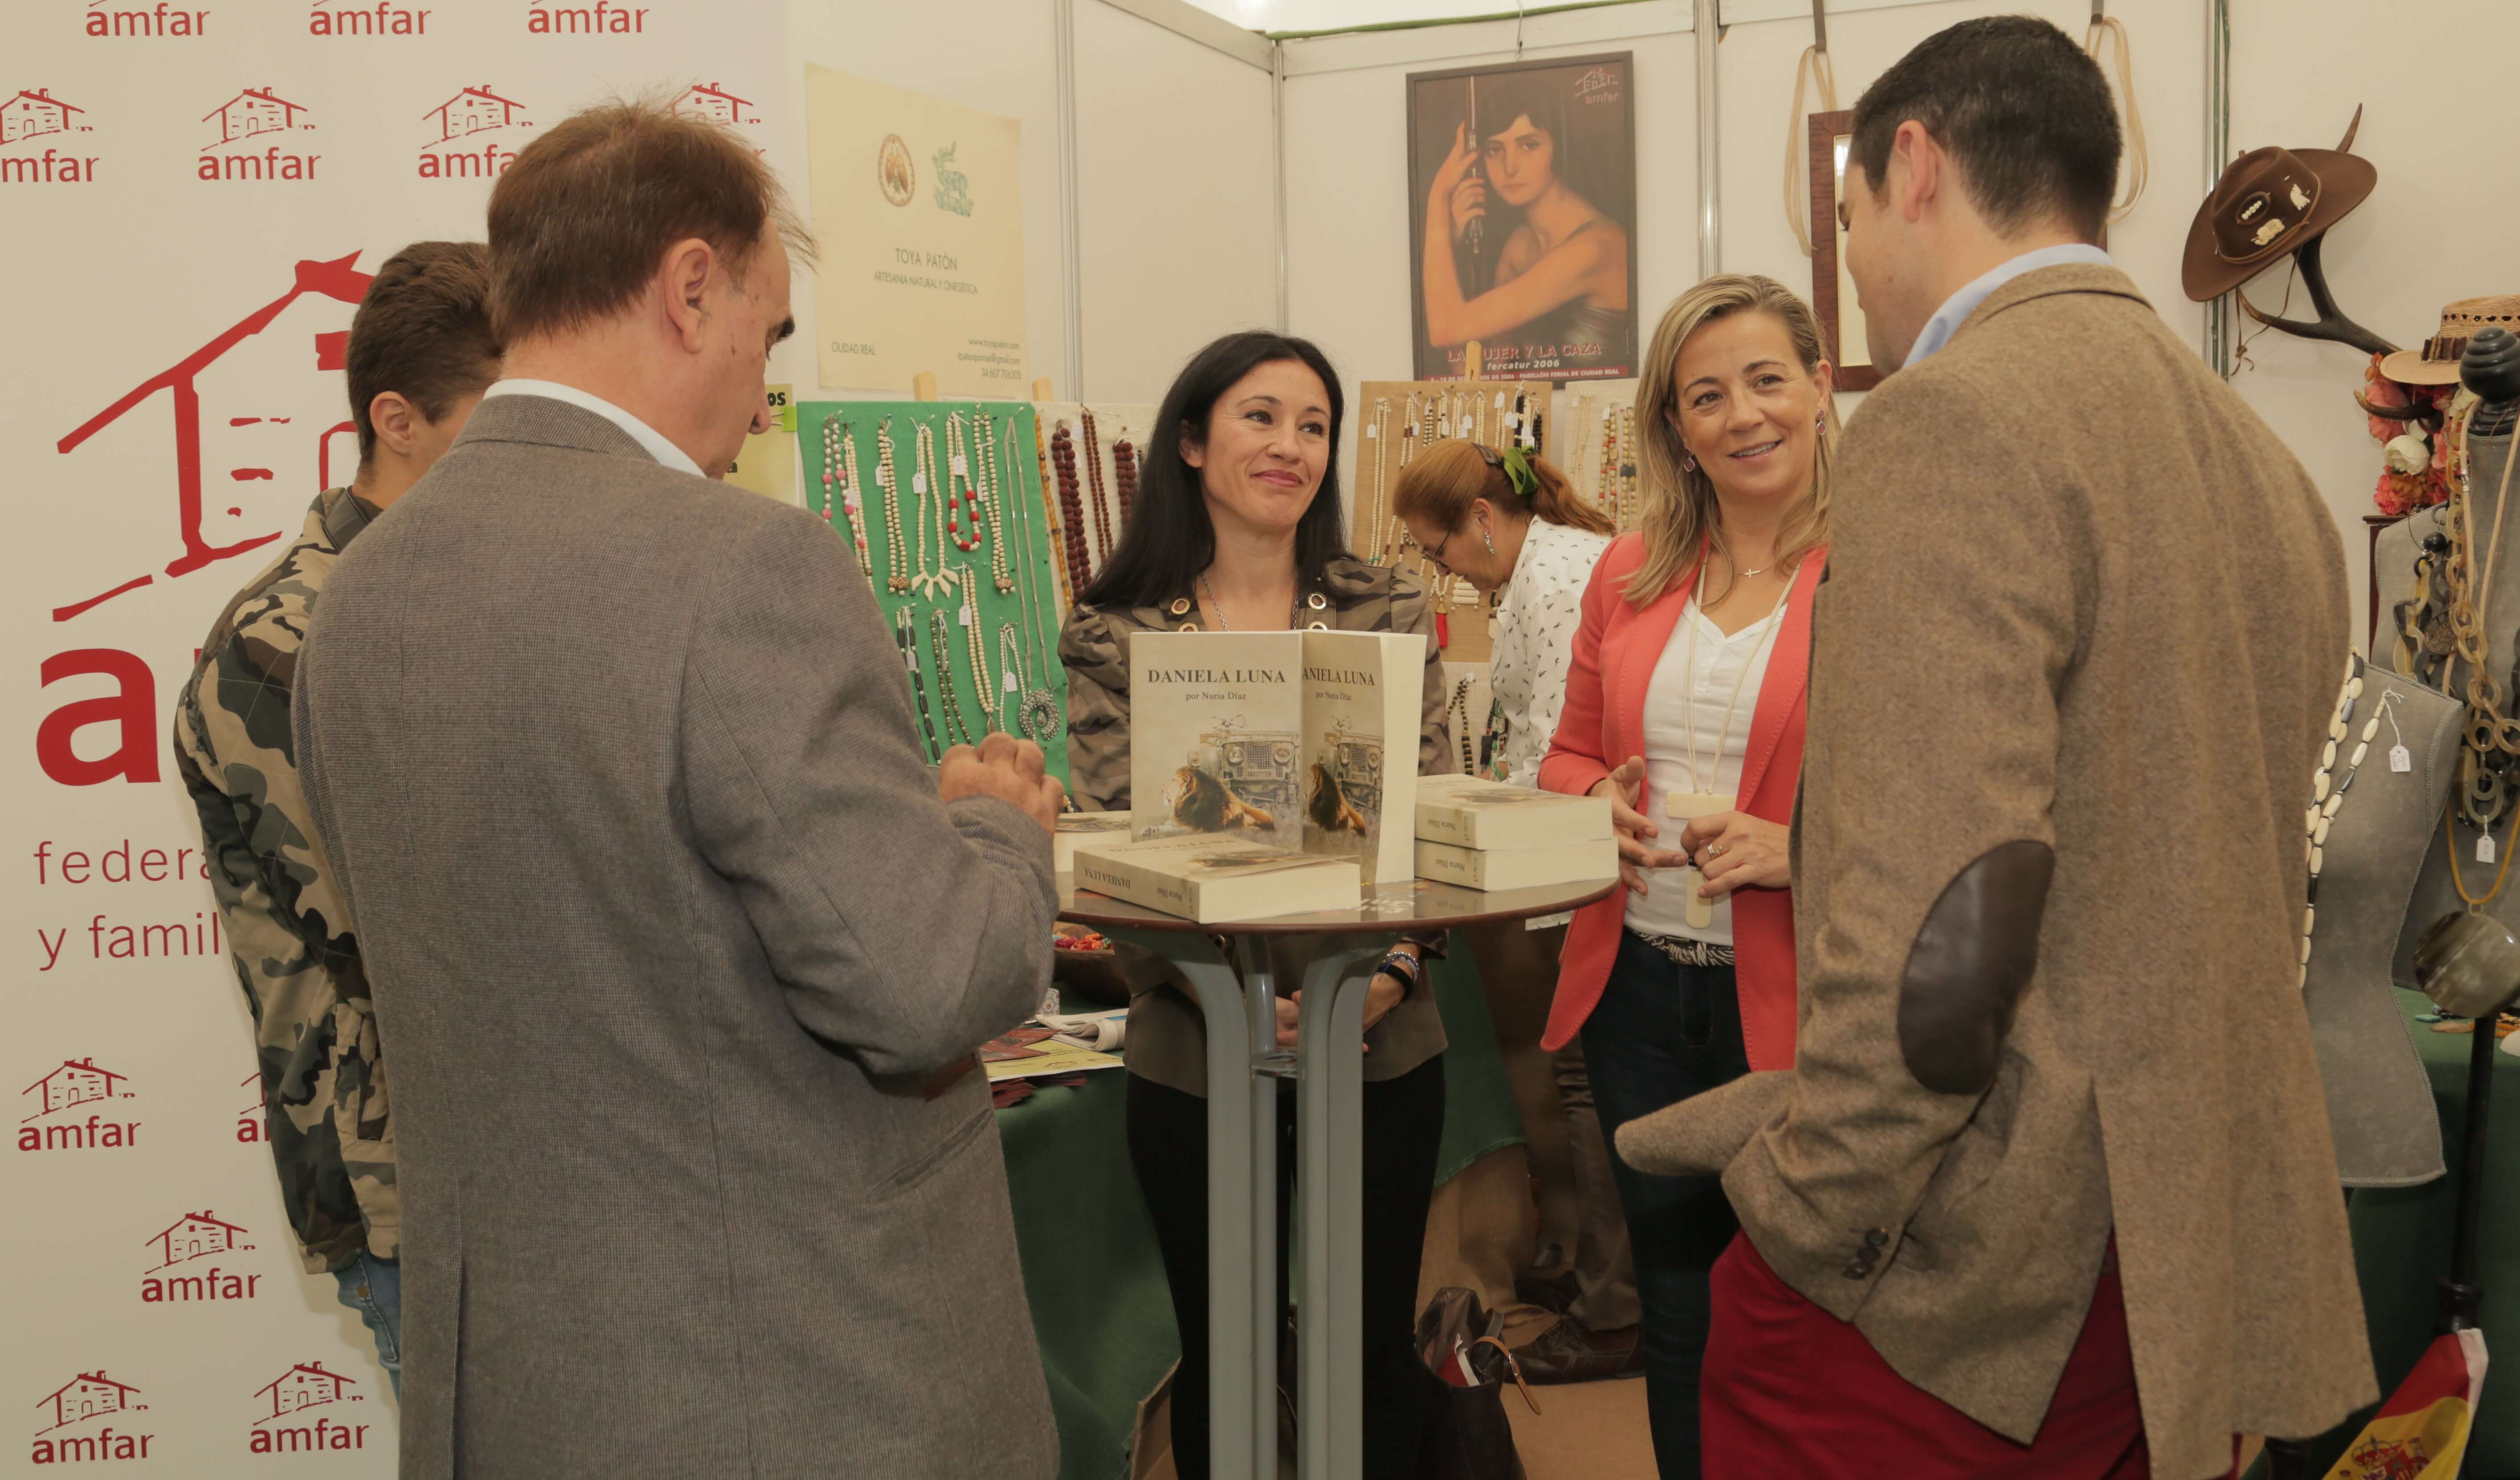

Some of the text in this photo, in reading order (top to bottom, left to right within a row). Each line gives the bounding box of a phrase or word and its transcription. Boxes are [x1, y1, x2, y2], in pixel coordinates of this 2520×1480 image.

[86, 2, 211, 37] amfar
[309, 2, 432, 36] amfar
[528, 0, 649, 34] amfar
[197, 146, 322, 180] amfar
[895, 248, 957, 271] TOYA PATÓN
[909, 276, 937, 289] NATURAL
[938, 280, 943, 289] Y
[831, 342, 876, 355] CIUDAD REAL
[1447, 342, 1602, 362] LA UJER Y LA CAZA
[1487, 359, 1560, 371] fercatur 2006
[1519, 371, 1549, 379] PABELLÓN
[1148, 669, 1286, 683] DANIELA LUNA
[1344, 670, 1375, 686] LUNA
[1186, 691, 1247, 701] por Nuria Díaz
[1316, 691, 1324, 699] por
[1325, 691, 1339, 699] Nuria
[1084, 867, 1101, 880] LUNA
[1102, 872, 1131, 889] DANIELA
[37, 927, 67, 971] y
[18, 1116, 141, 1151] amfar
[142, 1268, 261, 1302] amfar
[249, 1418, 369, 1453] amfar
[32, 1428, 154, 1464] amfar
